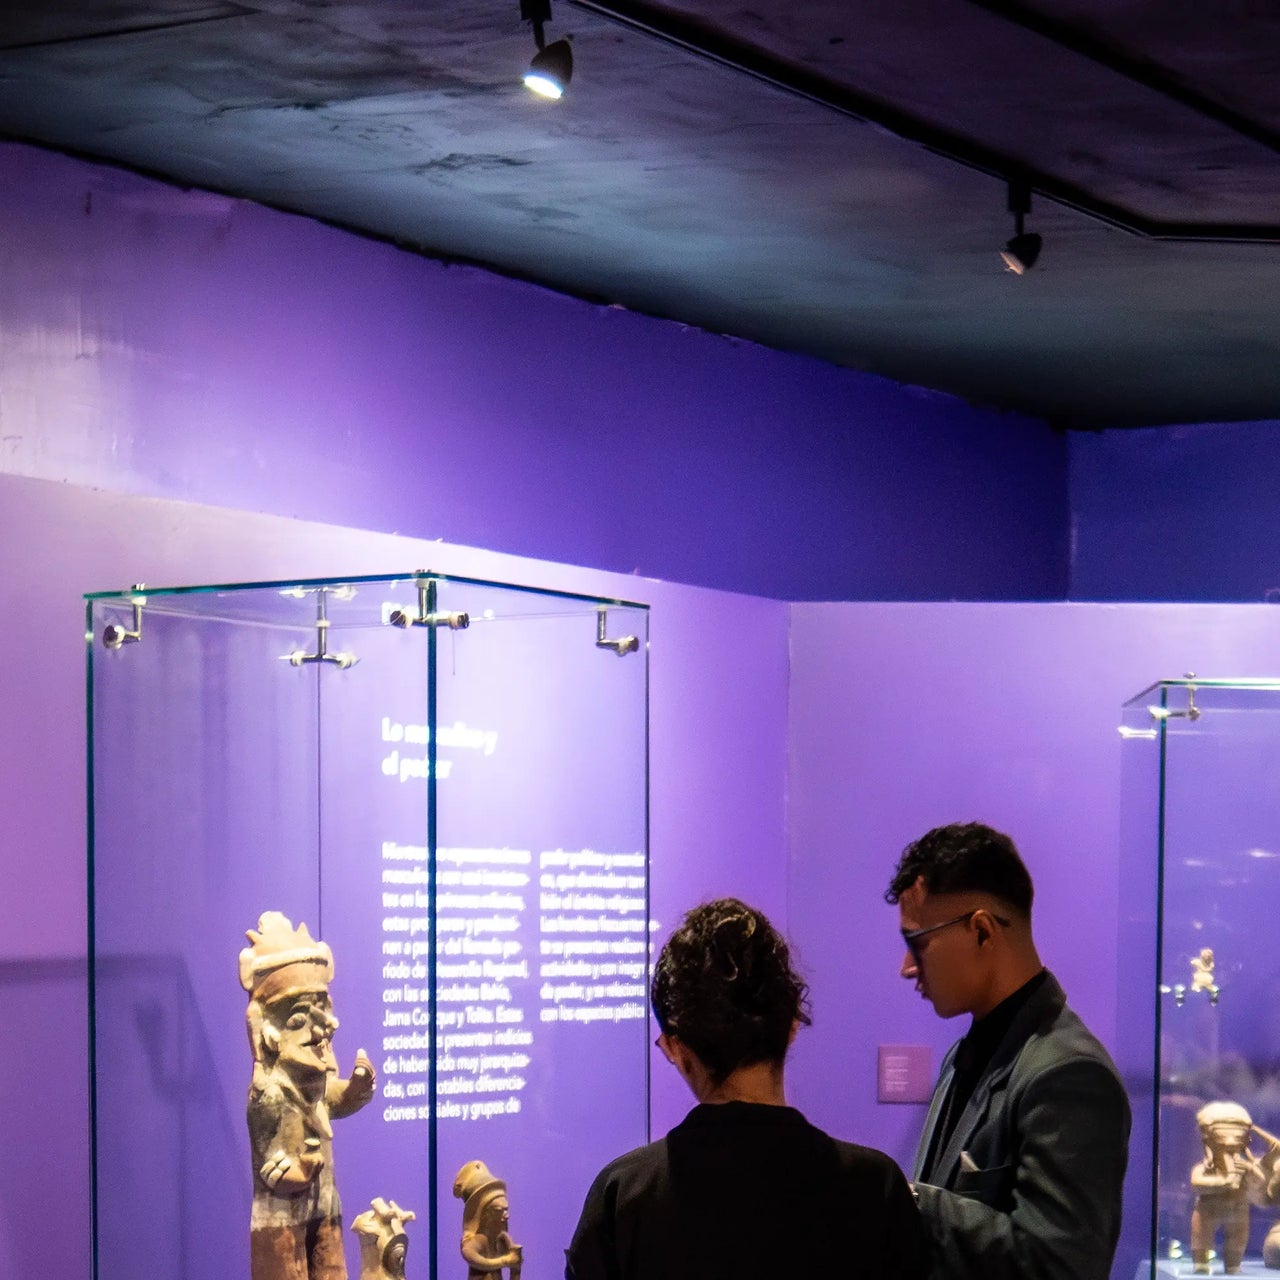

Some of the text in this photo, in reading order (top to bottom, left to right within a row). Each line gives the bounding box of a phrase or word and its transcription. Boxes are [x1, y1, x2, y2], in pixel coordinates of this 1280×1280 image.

[382, 988, 402, 1002] con
[383, 1009, 411, 1027] Jama
[412, 1007, 456, 1029] Coque
[456, 1012, 465, 1028] y
[383, 1031, 443, 1050] sociedads
[383, 1056, 397, 1074] de
[399, 1055, 430, 1073] haber
[433, 1054, 455, 1071] ido
[457, 1056, 479, 1074] muy
[383, 1080, 405, 1099] das,
[407, 1082, 426, 1097] con
[432, 1076, 474, 1095] otables
[383, 1096, 521, 1121] ciones soiales y grupos de
